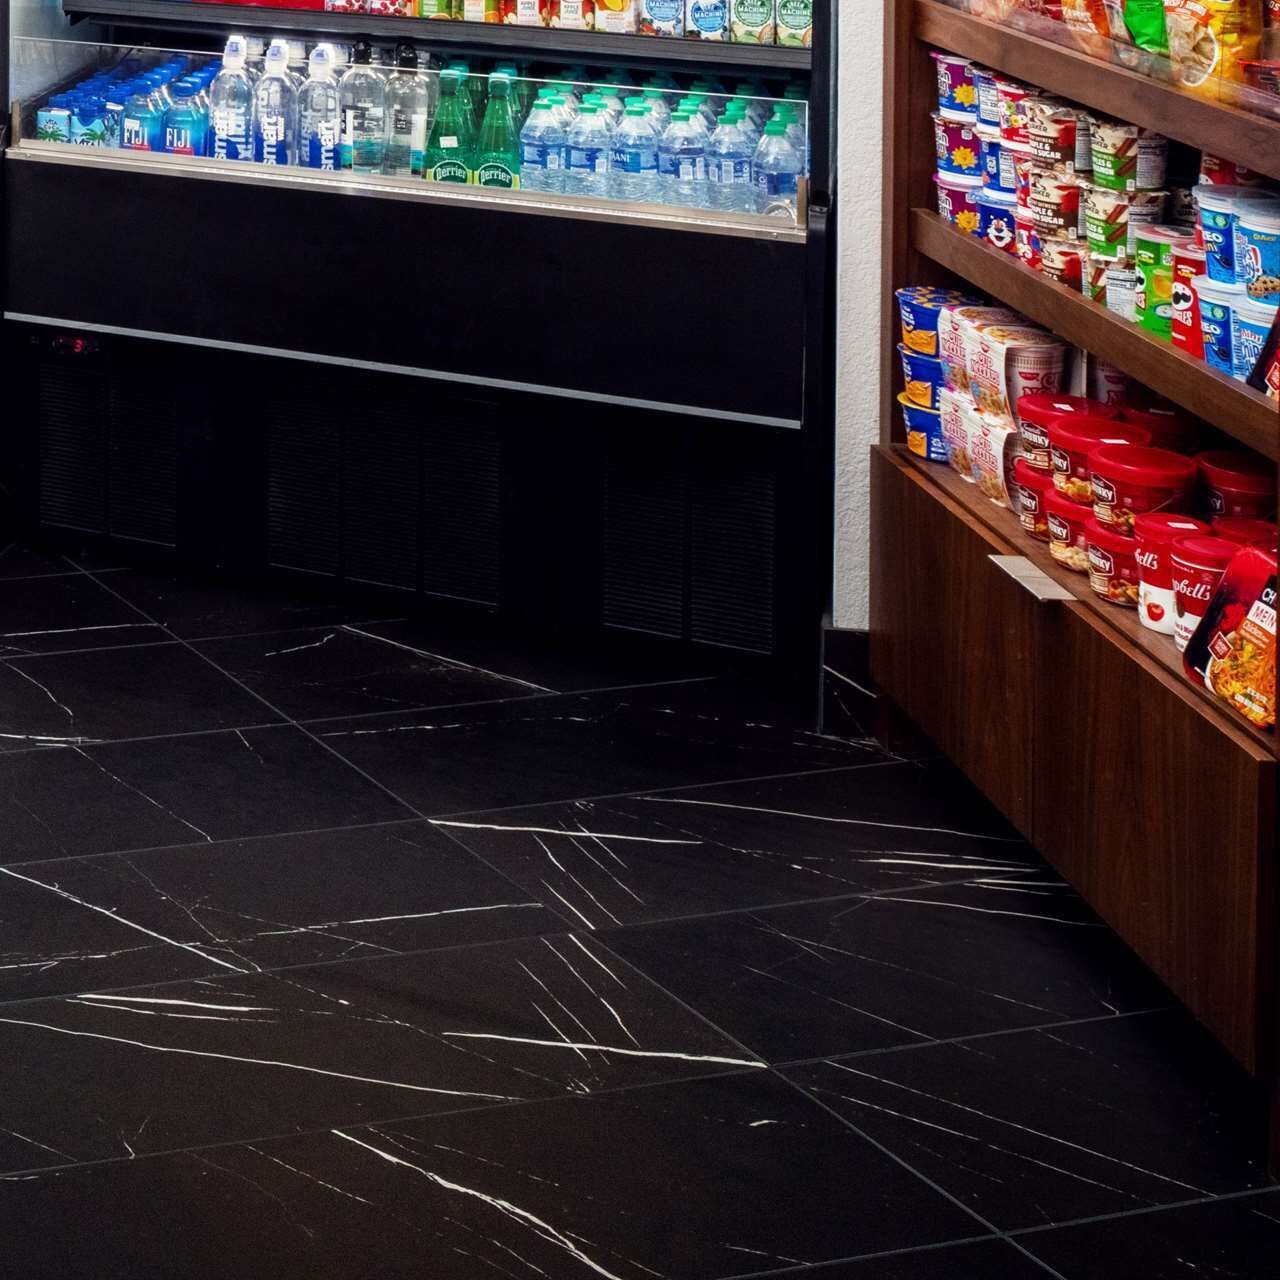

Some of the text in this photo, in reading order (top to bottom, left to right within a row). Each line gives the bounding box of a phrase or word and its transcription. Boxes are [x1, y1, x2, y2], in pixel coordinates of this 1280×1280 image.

[124, 129, 149, 146] FIJI
[166, 127, 191, 147] FIJI
[436, 165, 469, 183] Perrier
[478, 168, 512, 186] Perrier
